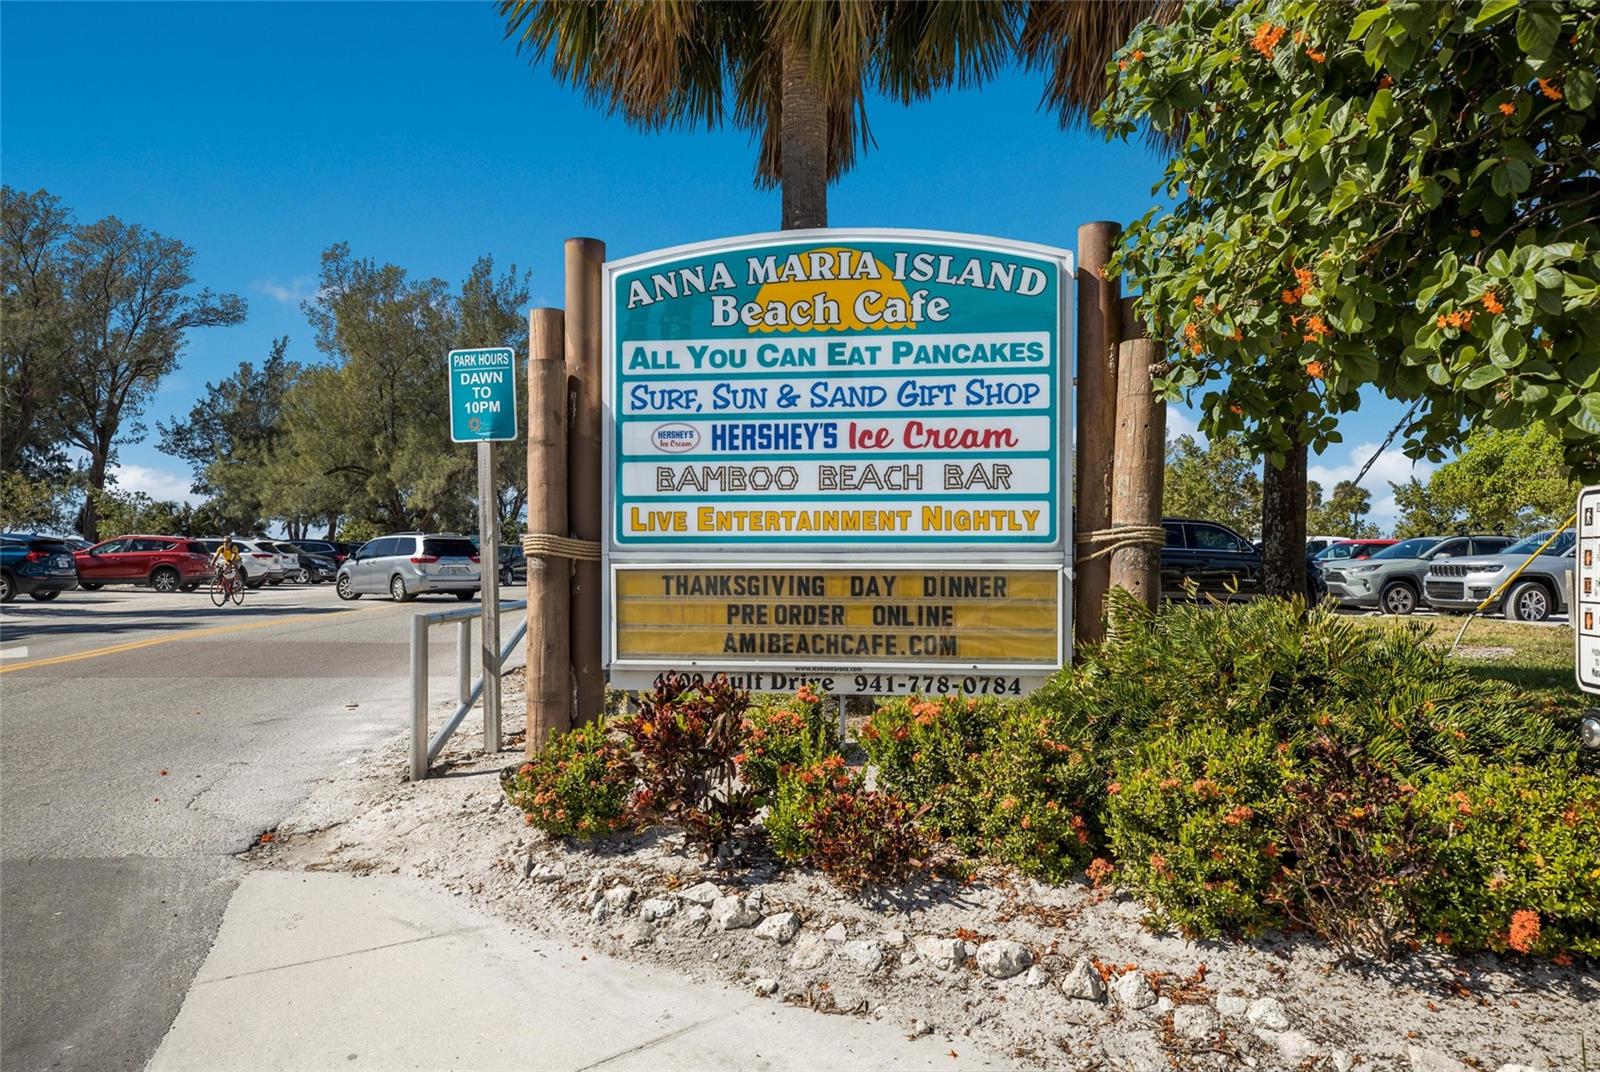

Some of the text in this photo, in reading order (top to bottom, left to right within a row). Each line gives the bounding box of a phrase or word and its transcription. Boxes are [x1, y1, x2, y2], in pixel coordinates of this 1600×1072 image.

[627, 251, 1048, 309] ANNA MARIA ISLAND
[710, 289, 950, 328] Beach Cafe
[454, 352, 509, 367] PARK HOURS
[628, 340, 1045, 370] ALL YOU CAN EAT PANCAKES
[460, 371, 503, 385] DAWN
[472, 386, 492, 399] TO
[630, 378, 1041, 413] SURF, SUN & SAND GIFT SHOP
[464, 400, 501, 414] 10PM
[658, 431, 694, 439] HERSHEY'S
[660, 439, 668, 447] Ice
[711, 420, 1019, 451] HERSHEY'S Ice Cream
[656, 463, 1013, 492] BAMBOO BEACH BAR
[630, 505, 1041, 532] LIVE ENTERTAINMENT NIGHTLY
[662, 575, 1007, 598] THANKSGIVING DAY DINNER
[727, 604, 953, 627] PRE ORDER ONLINE
[722, 632, 957, 657] AMIBEACHCAFE.COM
[770, 672, 835, 692] Drive
[854, 674, 1022, 696] 941-778-0784
